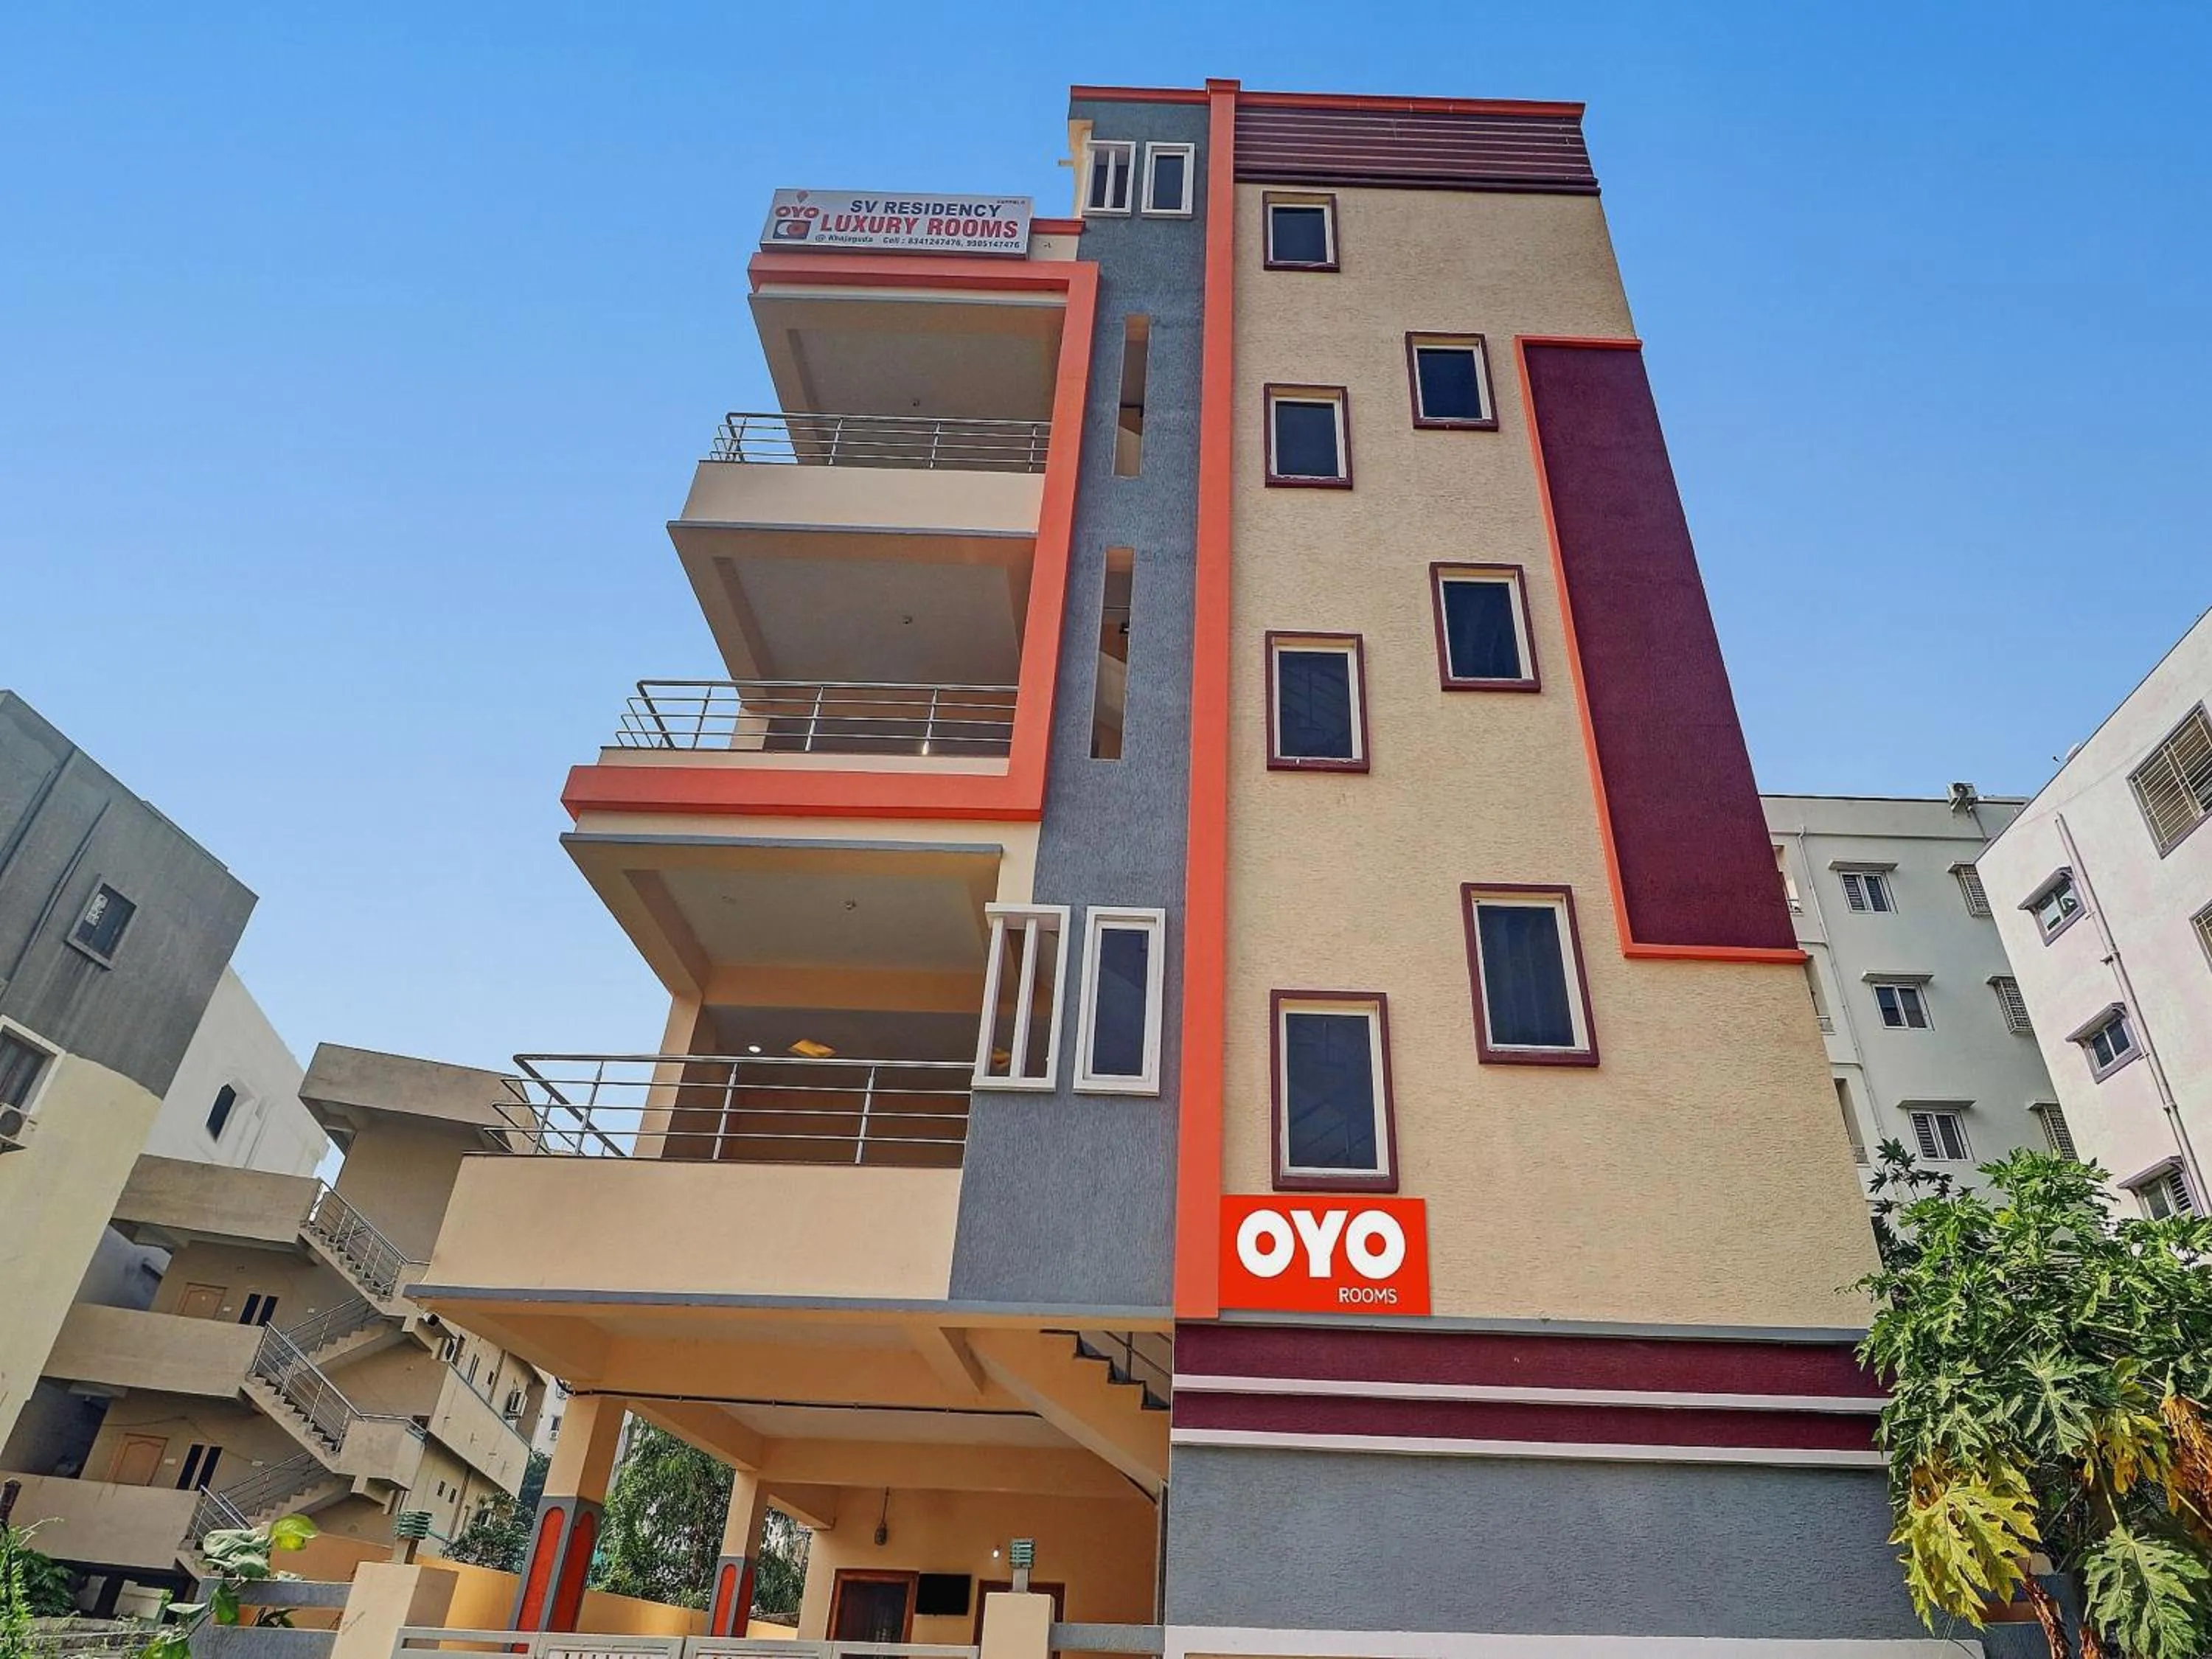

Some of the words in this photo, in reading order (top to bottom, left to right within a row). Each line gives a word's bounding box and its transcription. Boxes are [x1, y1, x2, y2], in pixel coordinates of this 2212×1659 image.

[776, 206, 819, 218] OYO
[850, 201, 878, 213] SV
[883, 201, 1002, 218] RESIDENCY
[820, 214, 919, 234] LUXURY
[927, 218, 1018, 238] ROOMS
[1237, 1209, 1406, 1279] OYO
[1338, 1287, 1397, 1304] ROOMS
